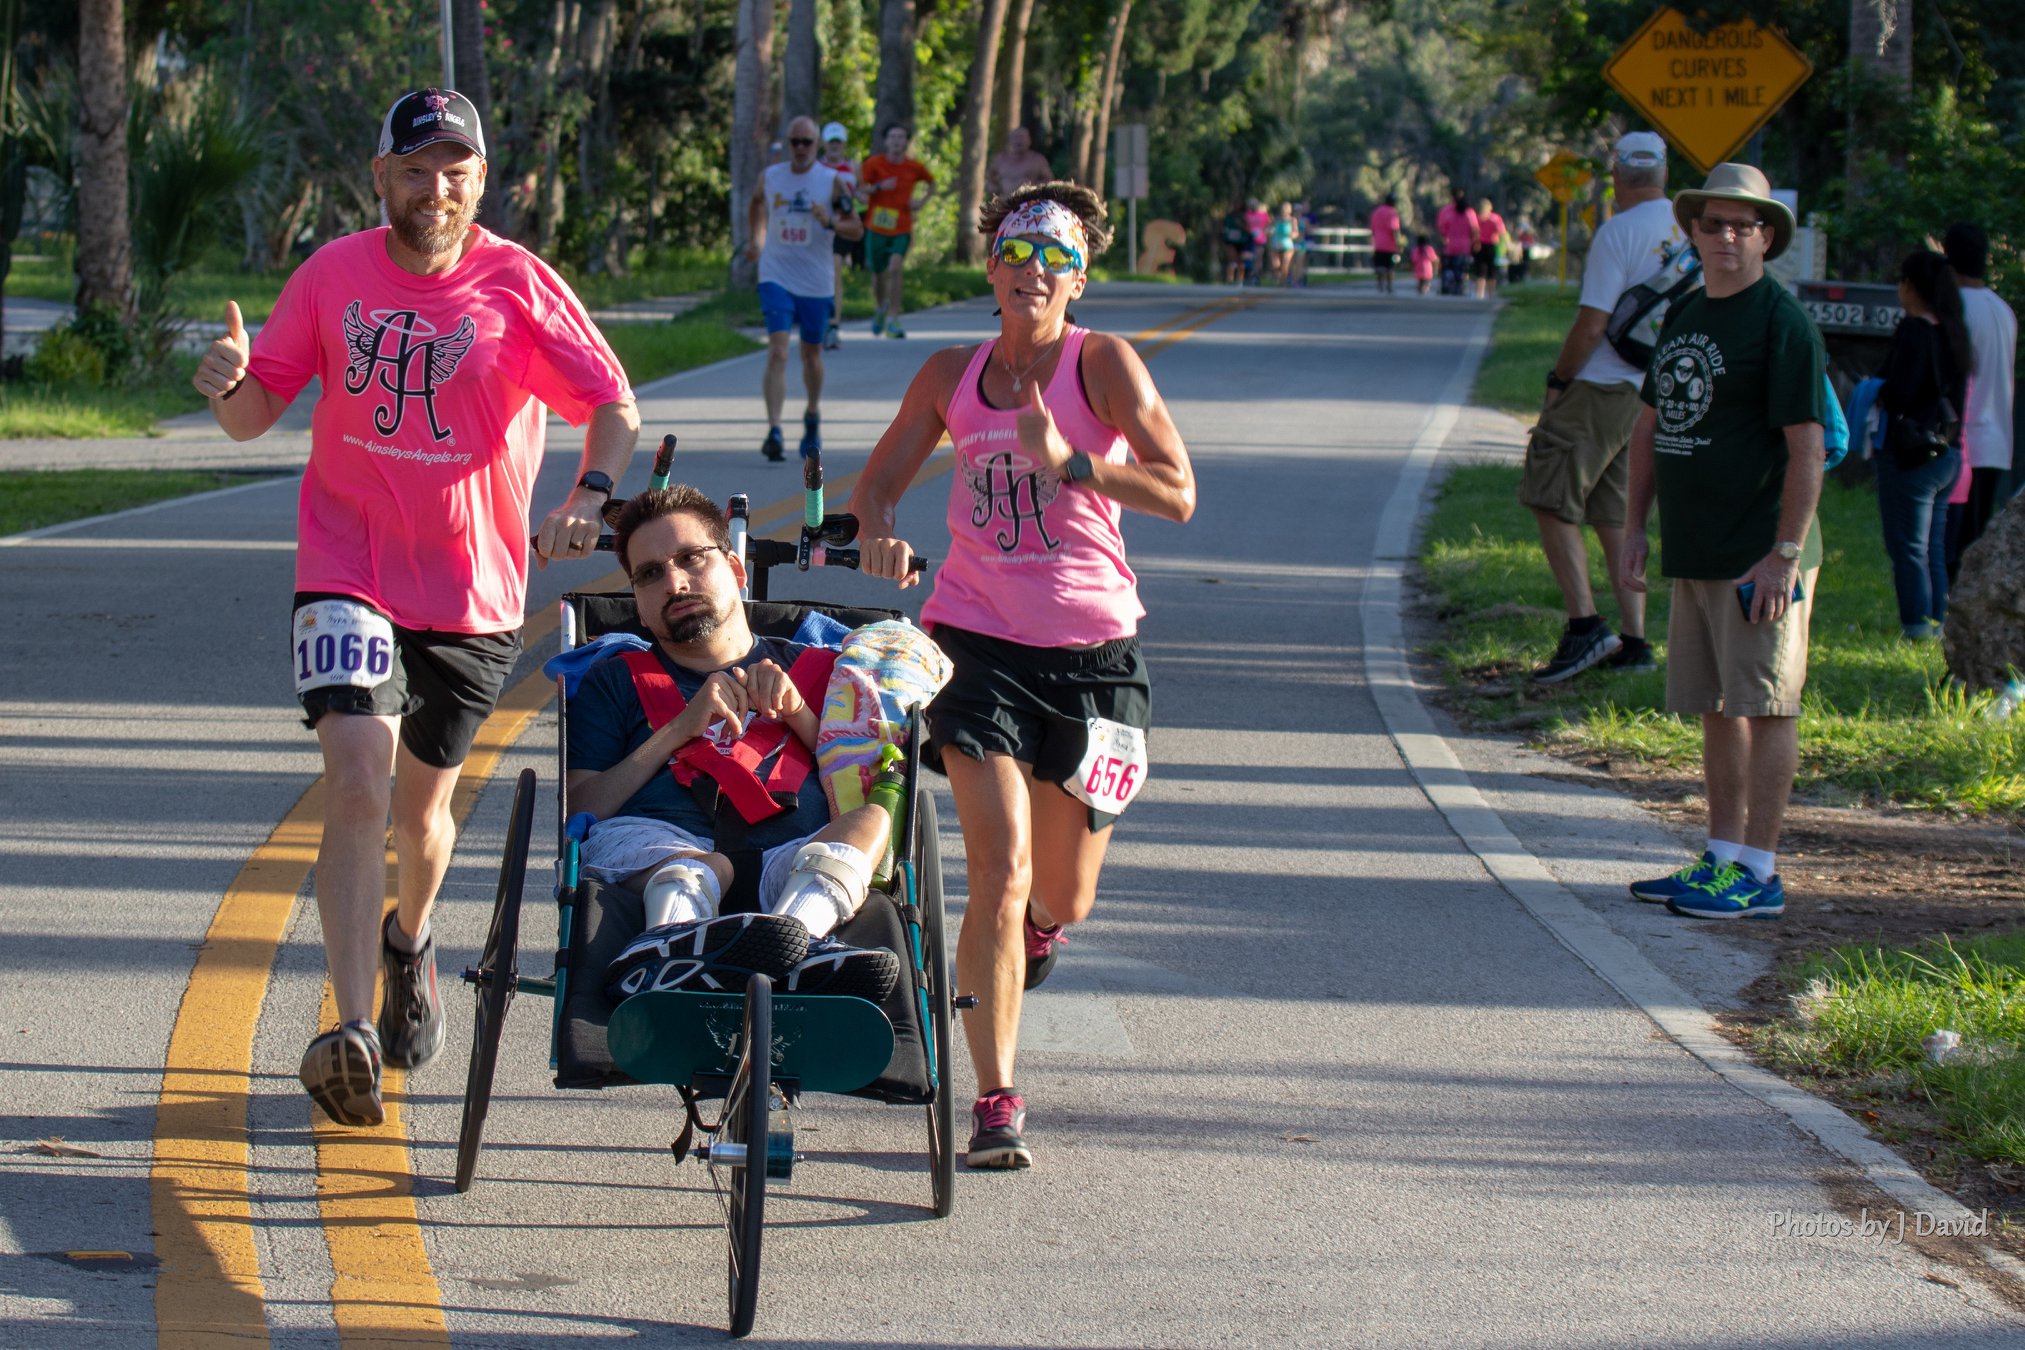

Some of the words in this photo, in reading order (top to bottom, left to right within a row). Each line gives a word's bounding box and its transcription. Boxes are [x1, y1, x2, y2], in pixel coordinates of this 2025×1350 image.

[1670, 57, 1747, 79] CURVES
[1651, 86, 1698, 108] NEXT
[1705, 87, 1714, 107] 1
[1724, 86, 1766, 108] MILE
[1688, 333, 1709, 348] AIR
[1706, 343, 1726, 376] RIDE
[1666, 409, 1687, 420] MILES
[343, 433, 473, 465] www.AinsleysAngels.org
[298, 634, 390, 681] 1066
[1085, 754, 1139, 801] 656
